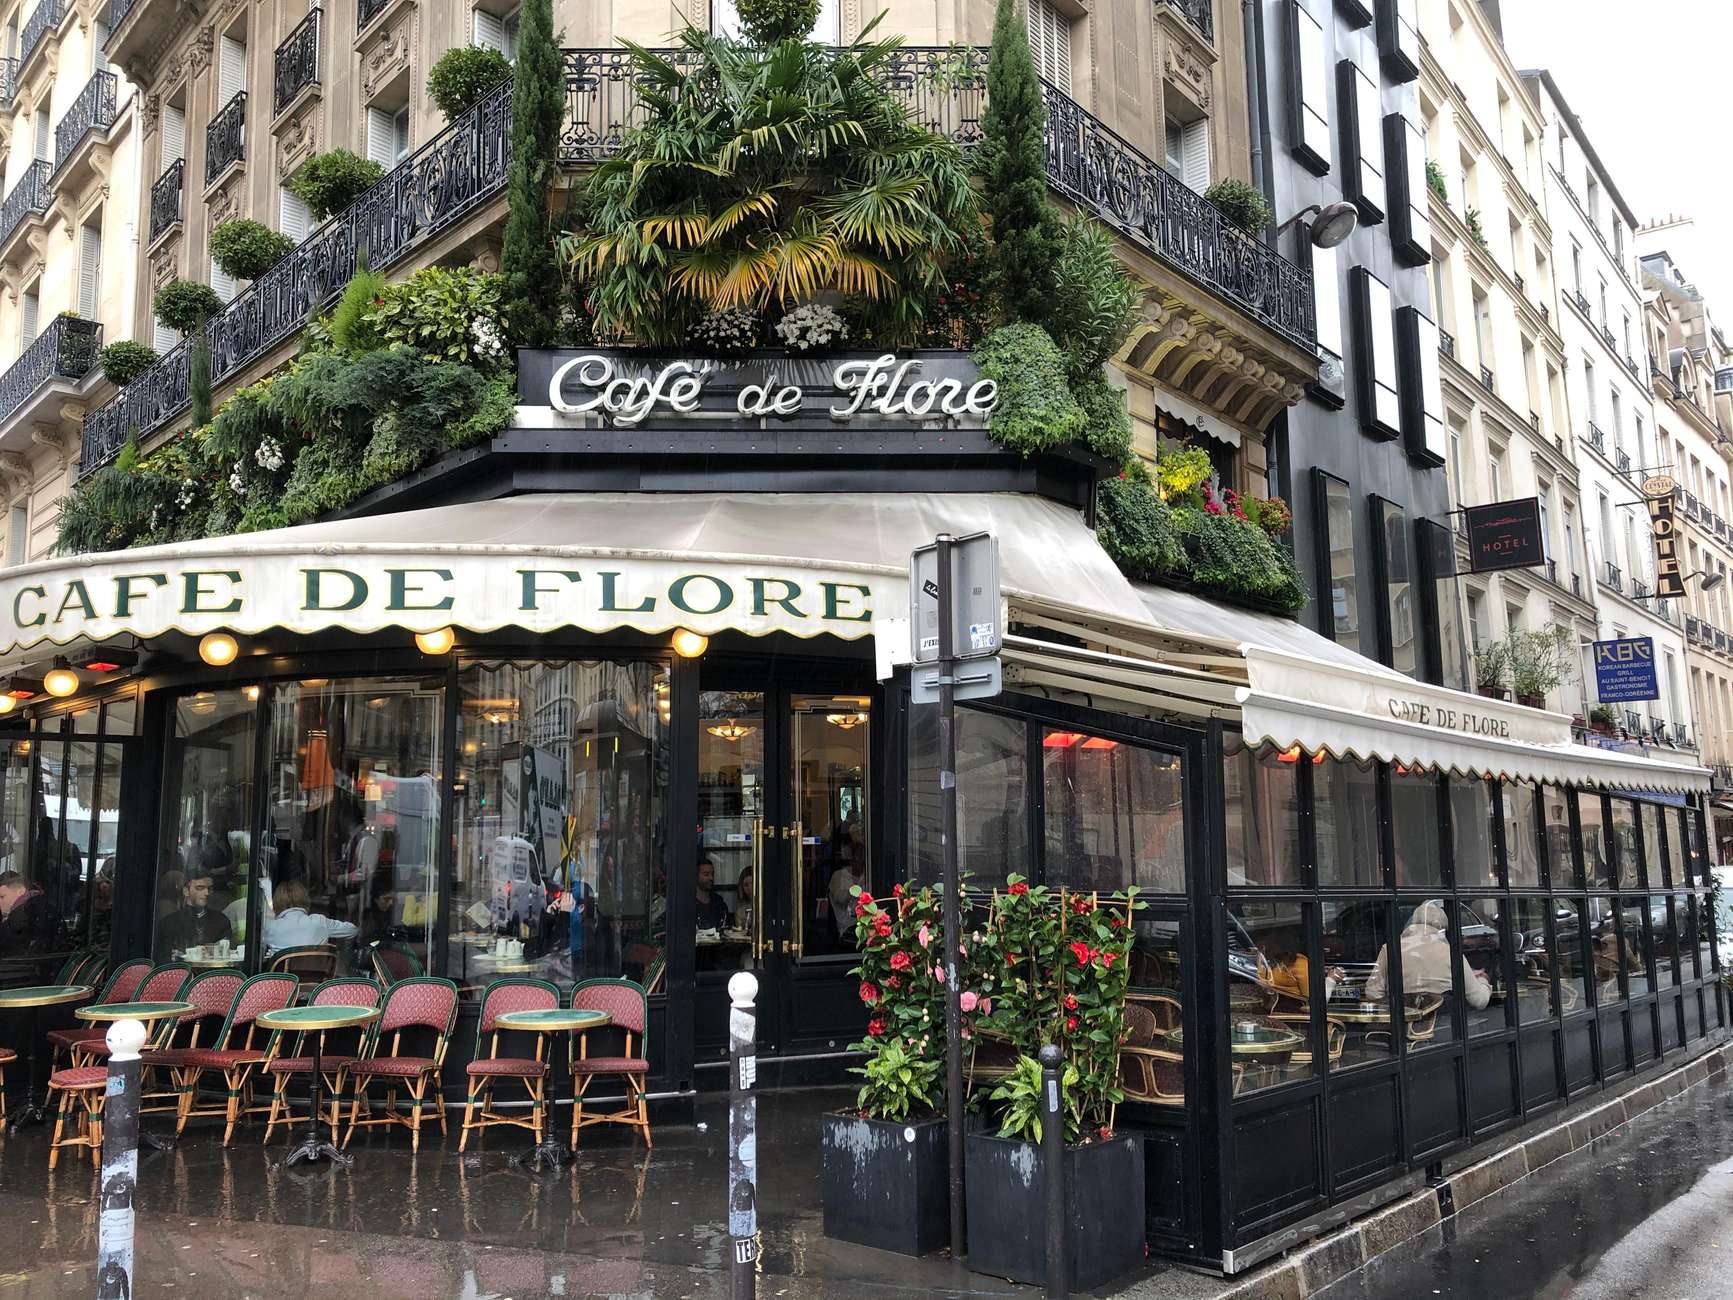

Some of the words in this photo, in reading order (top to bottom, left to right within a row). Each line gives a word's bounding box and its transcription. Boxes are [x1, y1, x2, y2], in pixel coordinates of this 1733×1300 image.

[548, 355, 711, 427] Café
[737, 375, 802, 416] de
[830, 353, 999, 418] Flore
[1482, 536, 1529, 553] HOTEL
[1648, 498, 1683, 595] HOTEL
[12, 570, 244, 629] CAFE
[299, 568, 456, 612] DE
[514, 569, 874, 623] FLORE
[1598, 663, 1621, 671] KOREAN
[1606, 682, 1648, 690] GASTRONOMIE
[1388, 698, 1431, 725] CAFE
[1436, 708, 1457, 729] DE
[1462, 713, 1510, 738] FLORE
